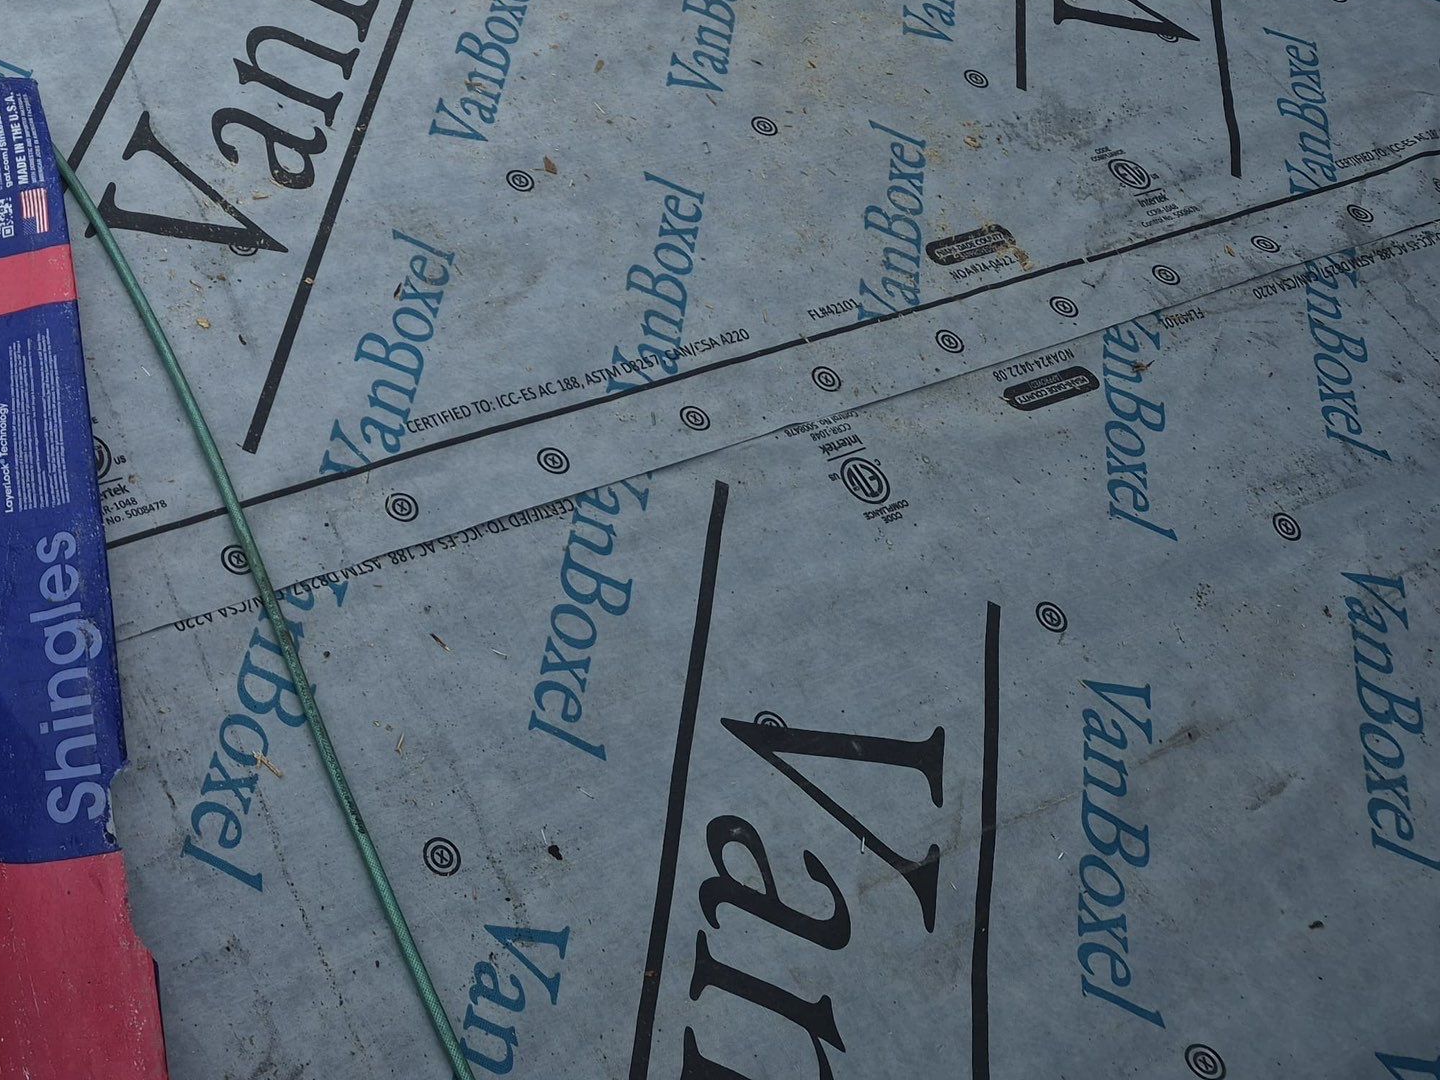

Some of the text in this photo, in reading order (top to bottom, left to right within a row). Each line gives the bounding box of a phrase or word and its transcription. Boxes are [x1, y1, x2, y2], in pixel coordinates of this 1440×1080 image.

[5, 91, 28, 185] MADE IN THE U.S.A.
[606, 171, 705, 395] VanBoxel
[858, 120, 927, 321] VanBoxel
[320, 229, 457, 478] VanBoxel
[406, 404, 471, 434] CERTIFIED
[470, 399, 497, 413] TO:
[495, 385, 538, 410] ICC-ES
[538, 380, 557, 398] AC
[559, 375, 584, 392] 188,
[584, 364, 625, 386] ASTM
[664, 337, 720, 363] CAN/CSA
[720, 328, 750, 347] A220
[807, 297, 860, 321] FL#42101
[0, 403, 9, 456] Technology
[113, 455, 127, 465] US
[818, 434, 863, 456] Intertek
[125, 500, 167, 519] 5008478
[29, 530, 107, 827] Shingles
[529, 471, 651, 762] VanBoxel
[1341, 571, 1440, 872] VanBoxel
[1078, 679, 1167, 1030] VanBoxel
